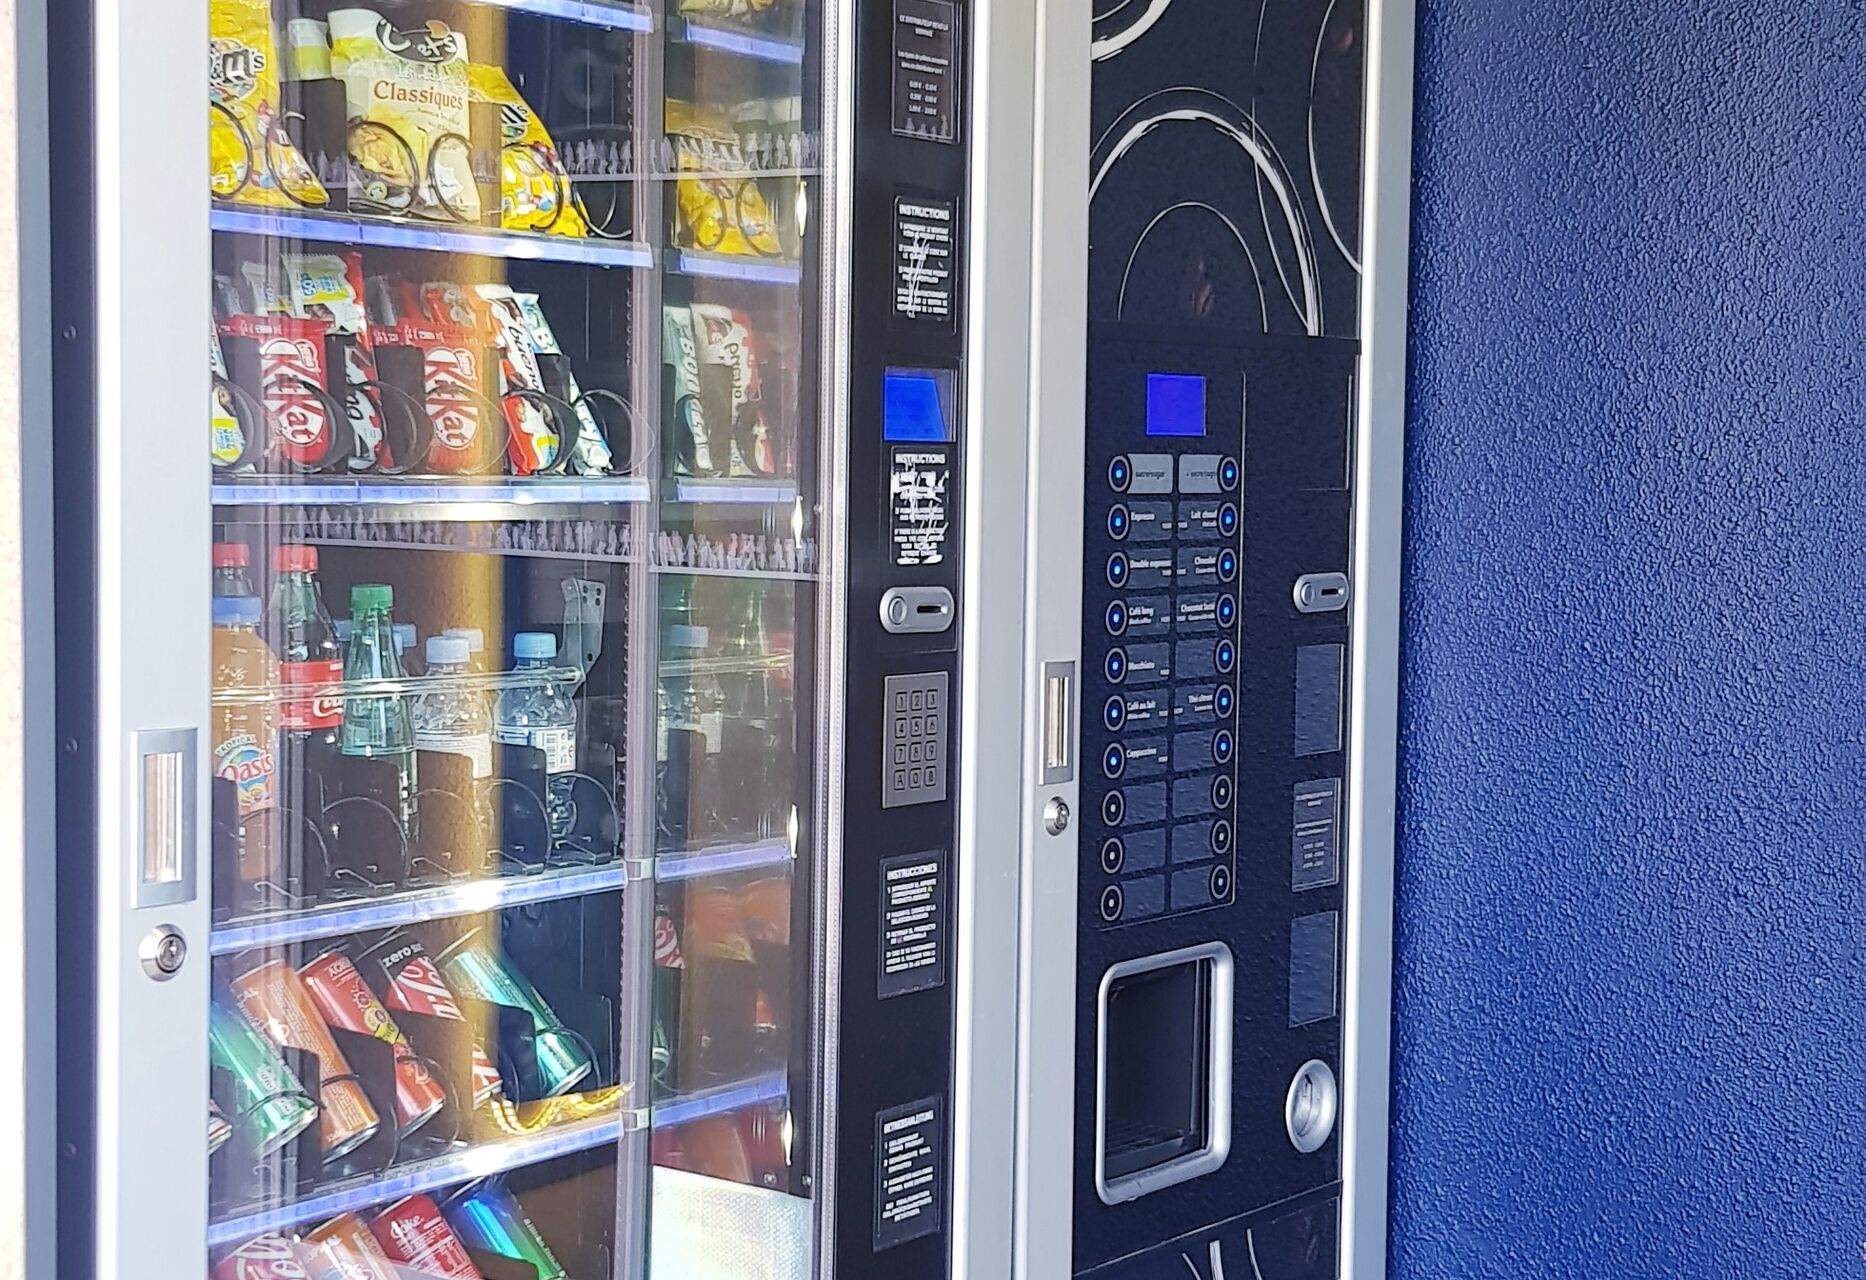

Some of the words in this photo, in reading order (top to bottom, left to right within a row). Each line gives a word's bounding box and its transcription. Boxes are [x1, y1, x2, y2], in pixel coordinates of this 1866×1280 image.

[373, 79, 463, 110] Classiques
[220, 754, 274, 782] Oasis
[382, 947, 411, 968] zero
